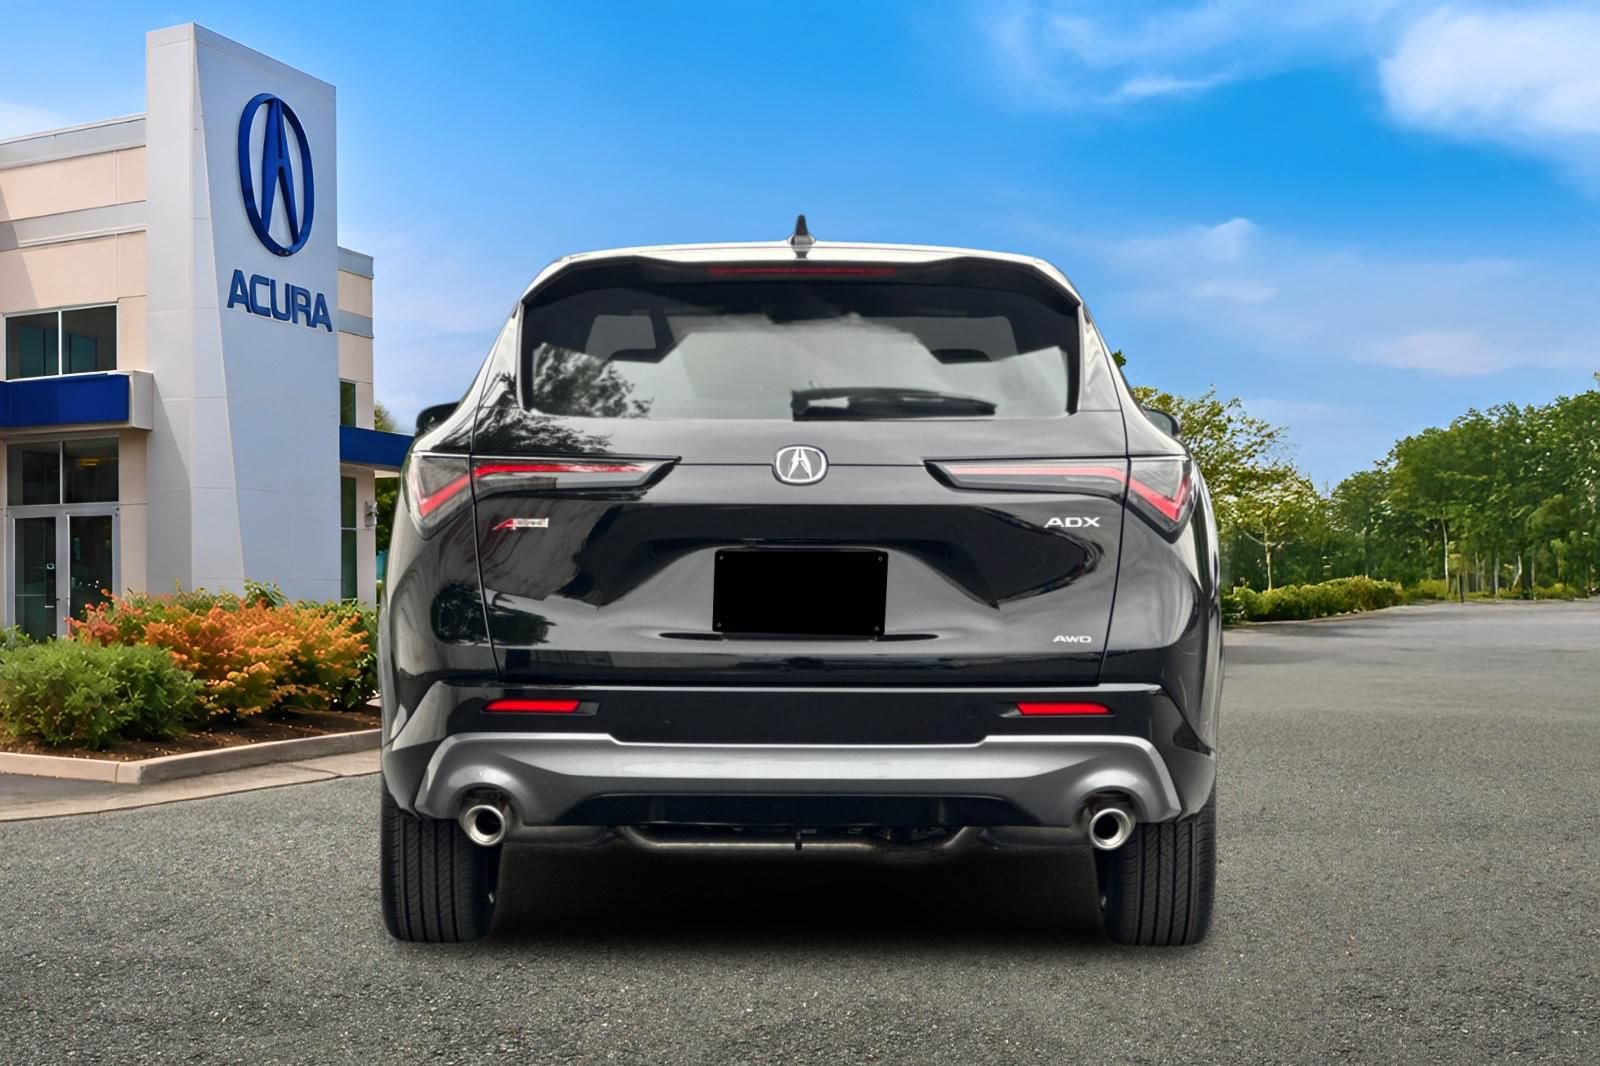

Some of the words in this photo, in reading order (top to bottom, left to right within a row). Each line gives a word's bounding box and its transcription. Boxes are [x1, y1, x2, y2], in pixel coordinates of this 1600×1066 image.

[227, 269, 332, 332] ACURA
[1044, 517, 1100, 528] ADX
[1053, 635, 1092, 643] AWD
